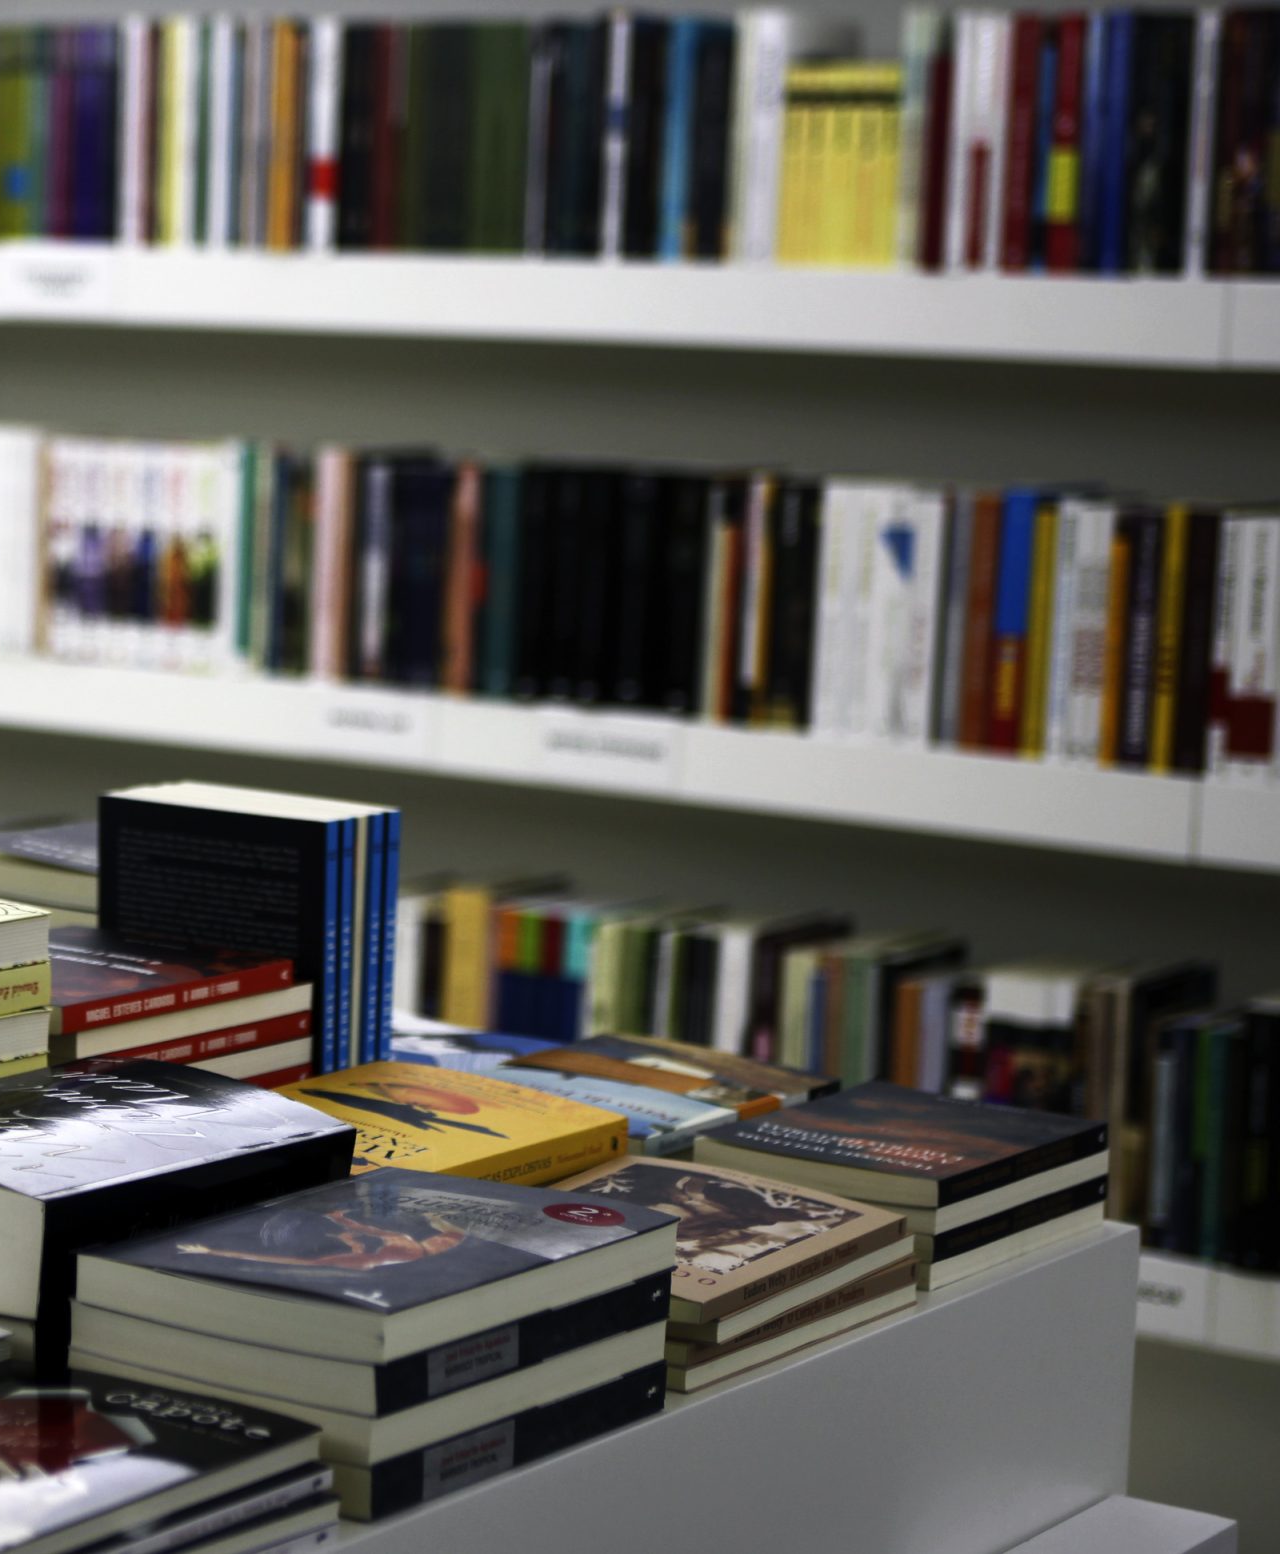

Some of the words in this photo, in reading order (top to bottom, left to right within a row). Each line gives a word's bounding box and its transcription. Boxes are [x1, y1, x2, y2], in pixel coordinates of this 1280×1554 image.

[8, 981, 39, 996] David
[86, 1003, 111, 1023] MIGUEL
[113, 999, 142, 1018] ESTEVES
[106, 1391, 272, 1441] Capote
